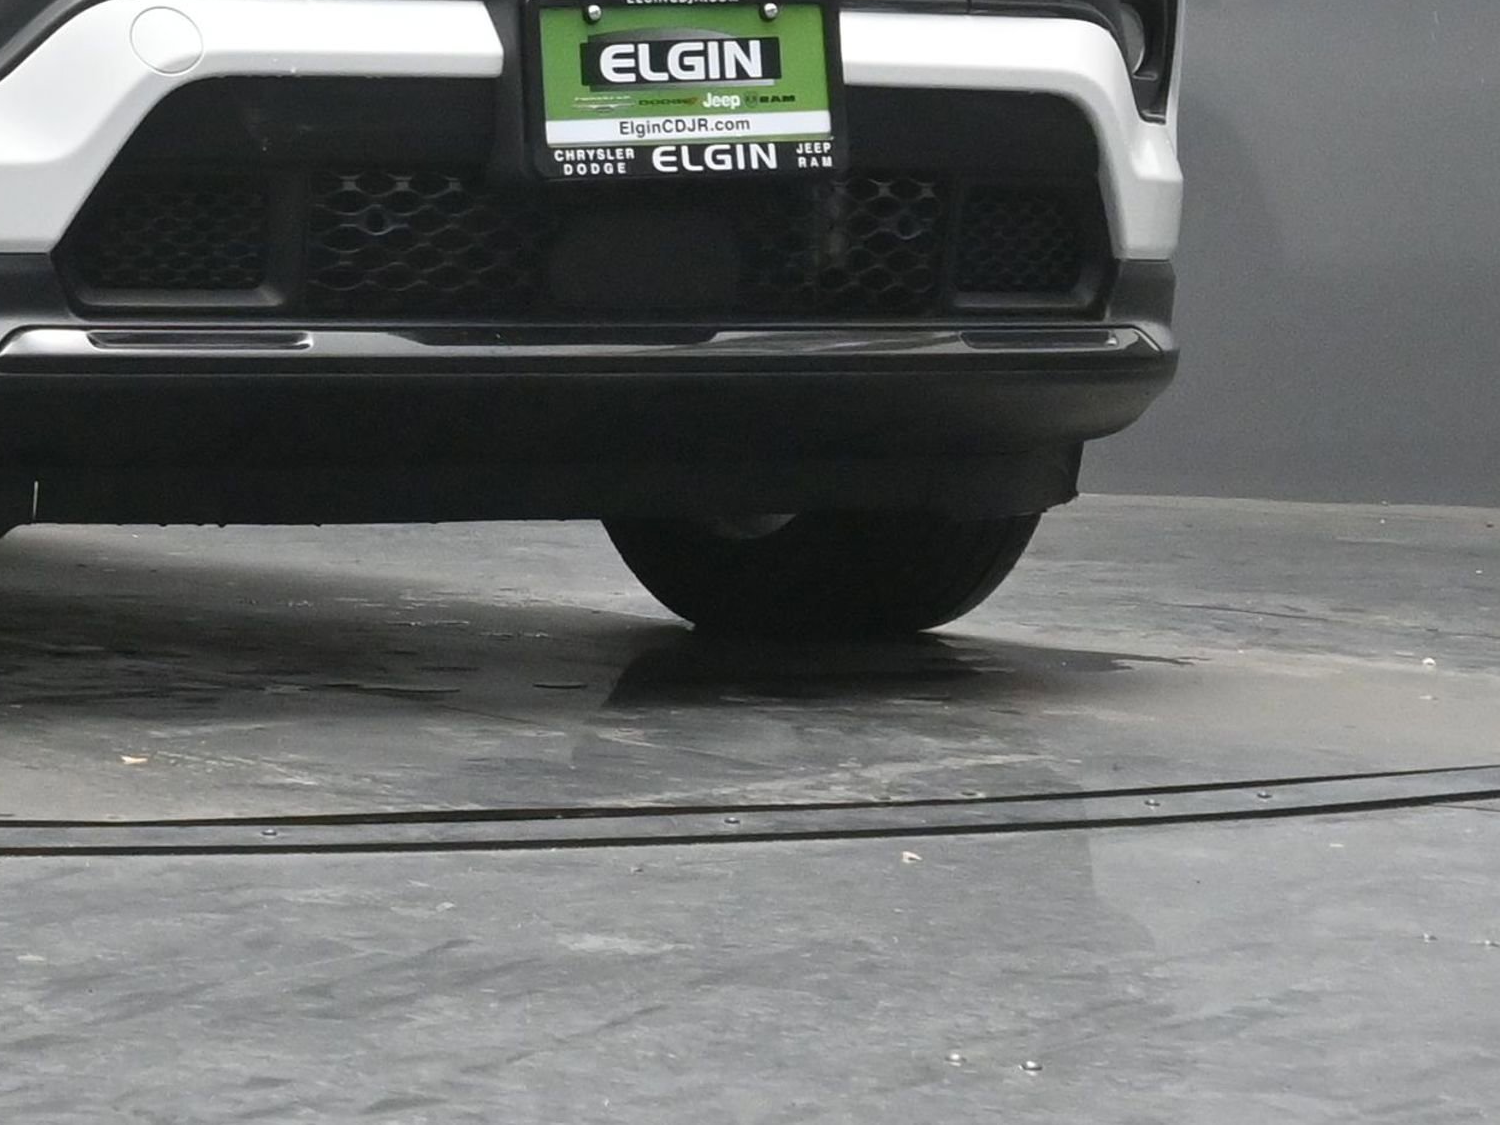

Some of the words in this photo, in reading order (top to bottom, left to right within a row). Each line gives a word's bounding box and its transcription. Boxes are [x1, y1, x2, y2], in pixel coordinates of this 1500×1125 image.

[600, 39, 764, 84] ELGIN
[703, 92, 741, 109] Jeep
[759, 94, 796, 104] RAM
[619, 118, 750, 138] ElginCDJR.com
[554, 148, 635, 162] CHRYSLER
[796, 142, 831, 156] JEEP
[652, 142, 778, 173] ELGIN
[797, 155, 833, 168] RAM
[563, 162, 627, 176] DODGE
